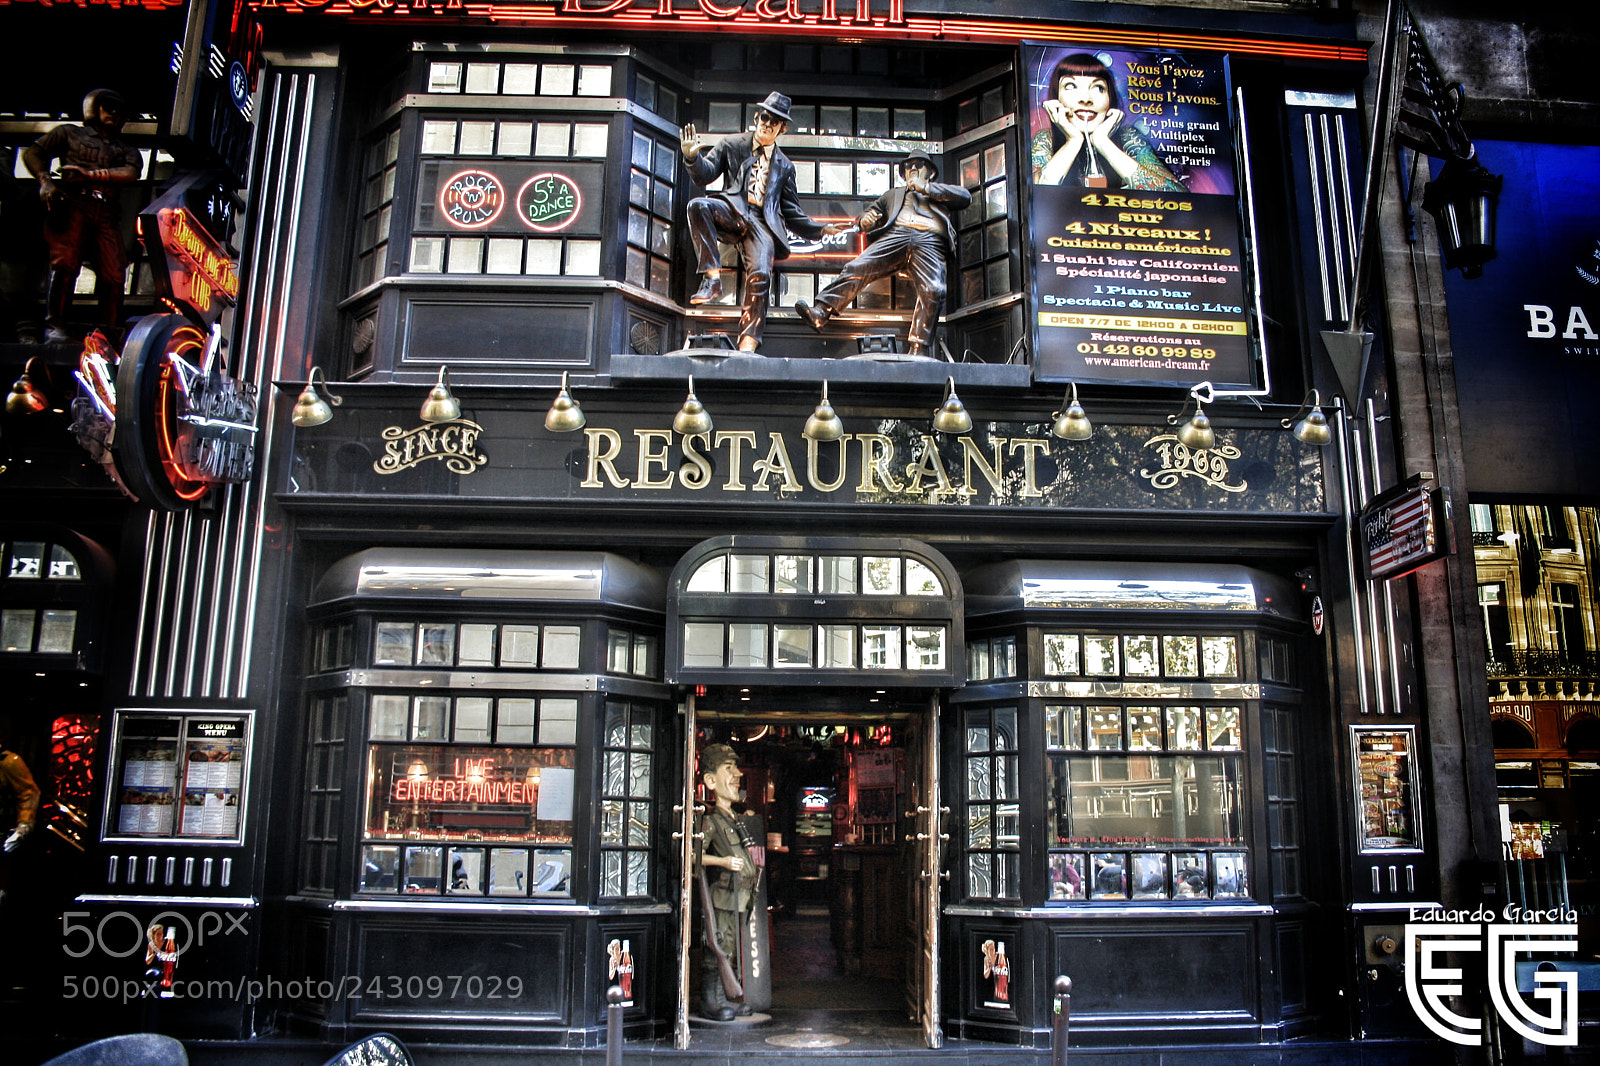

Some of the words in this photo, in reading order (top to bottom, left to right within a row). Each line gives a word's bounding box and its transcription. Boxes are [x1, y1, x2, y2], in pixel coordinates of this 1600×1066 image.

[1126, 62, 1160, 75] Vous
[1163, 64, 1205, 78] l'avez
[1127, 75, 1162, 88] Rêvé
[1172, 78, 1177, 89] !
[1128, 89, 1164, 102] Nous
[1166, 91, 1217, 105] l'avons
[1129, 102, 1163, 115] Créé
[1173, 105, 1178, 116] !
[1143, 117, 1158, 127] Le
[1160, 119, 1184, 129] plus
[1187, 121, 1220, 131] grand
[1150, 129, 1205, 143] Multiplex
[1157, 142, 1216, 155] Americain
[1164, 155, 1179, 164] de
[1181, 155, 1211, 167] Paris
[450, 175, 497, 195] ROCK
[559, 184, 569, 195] A
[529, 195, 574, 217] DANCE
[1081, 194, 1102, 207] 4
[1104, 194, 1193, 212] Restos
[449, 203, 493, 223] ROLL
[1118, 212, 1164, 224] sur
[1065, 221, 1087, 235] 4
[1088, 222, 1201, 241] Niveaux
[1204, 228, 1212, 241] !
[1047, 237, 1122, 250] Cuisine
[1124, 242, 1232, 256] américaine
[1040, 253, 1051, 263] 1
[1053, 254, 1106, 266] Sushi
[1107, 256, 1137, 267] bar
[1139, 259, 1239, 273] Californien
[1056, 266, 1142, 280] Spécialité
[1143, 271, 1227, 284] japonaise
[1094, 284, 1104, 294] 1
[1106, 285, 1159, 297] Piano
[1160, 288, 1192, 298] bar
[1043, 295, 1126, 308] Spectacle
[1128, 299, 1144, 309] &
[1146, 300, 1200, 312] Music
[1202, 302, 1242, 314] Live
[1050, 316, 1084, 325] OPEN
[1089, 318, 1109, 326] 7/7
[1114, 319, 1132, 327] DE
[1179, 322, 1188, 330] A
[1523, 304, 1599, 339] BA
[1090, 332, 1182, 345] Réservations
[1184, 338, 1201, 346] au
[1076, 342, 1100, 354] 01
[1102, 343, 1130, 356] 42
[1132, 344, 1159, 357] 60
[1161, 346, 1187, 358] 99
[1189, 347, 1217, 359] 89
[1084, 356, 1211, 371] www.american-dream.fr
[380, 422, 484, 472] SINCE
[580, 428, 1052, 497] RESTAURANT
[1151, 439, 1235, 486] 1969
[454, 758, 496, 779] LIVE
[395, 780, 538, 804] ENTERTAINMEN
